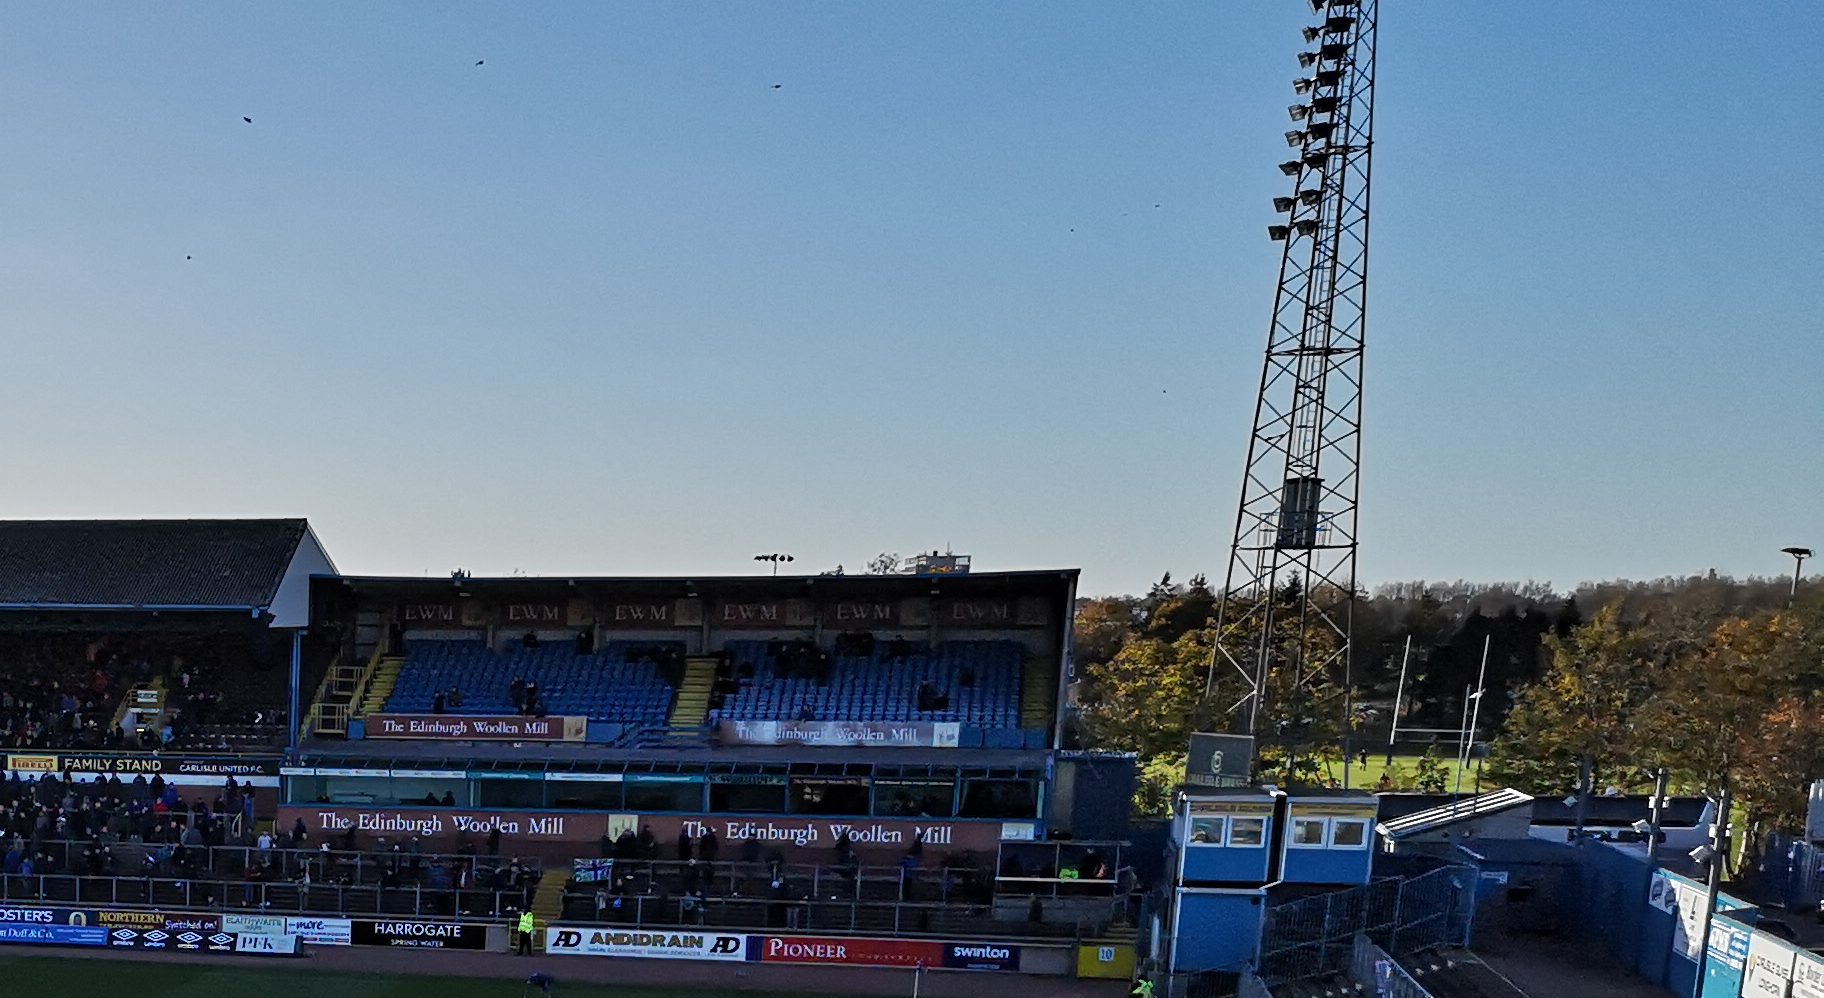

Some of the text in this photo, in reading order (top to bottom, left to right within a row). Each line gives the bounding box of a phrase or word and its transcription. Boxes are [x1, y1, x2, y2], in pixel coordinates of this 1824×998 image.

[383, 720, 549, 736] The Edinburgh Woollen Mill
[766, 726, 826, 742] dinburgh
[836, 723, 884, 741] Woollen
[892, 727, 918, 740] Mill
[64, 758, 113, 771] FAMILY
[116, 759, 162, 771] STAND
[179, 764, 217, 773] CARLISLE
[219, 765, 250, 773] UNITED
[319, 812, 565, 835] The Edinburgh Woollen Mill
[726, 822, 818, 846] Edinburgh
[829, 824, 902, 844] Woollen
[915, 825, 952, 844] Mill
[98, 912, 165, 924] NORTHERN
[296, 920, 325, 930] more
[374, 922, 462, 937] HARROGATE
[391, 938, 444, 948] SPRING WATER
[590, 932, 704, 949] ANDIDRAIN
[769, 938, 847, 959] PIONEER
[953, 946, 1009, 959] swinton
[1100, 949, 1113, 961] 10
